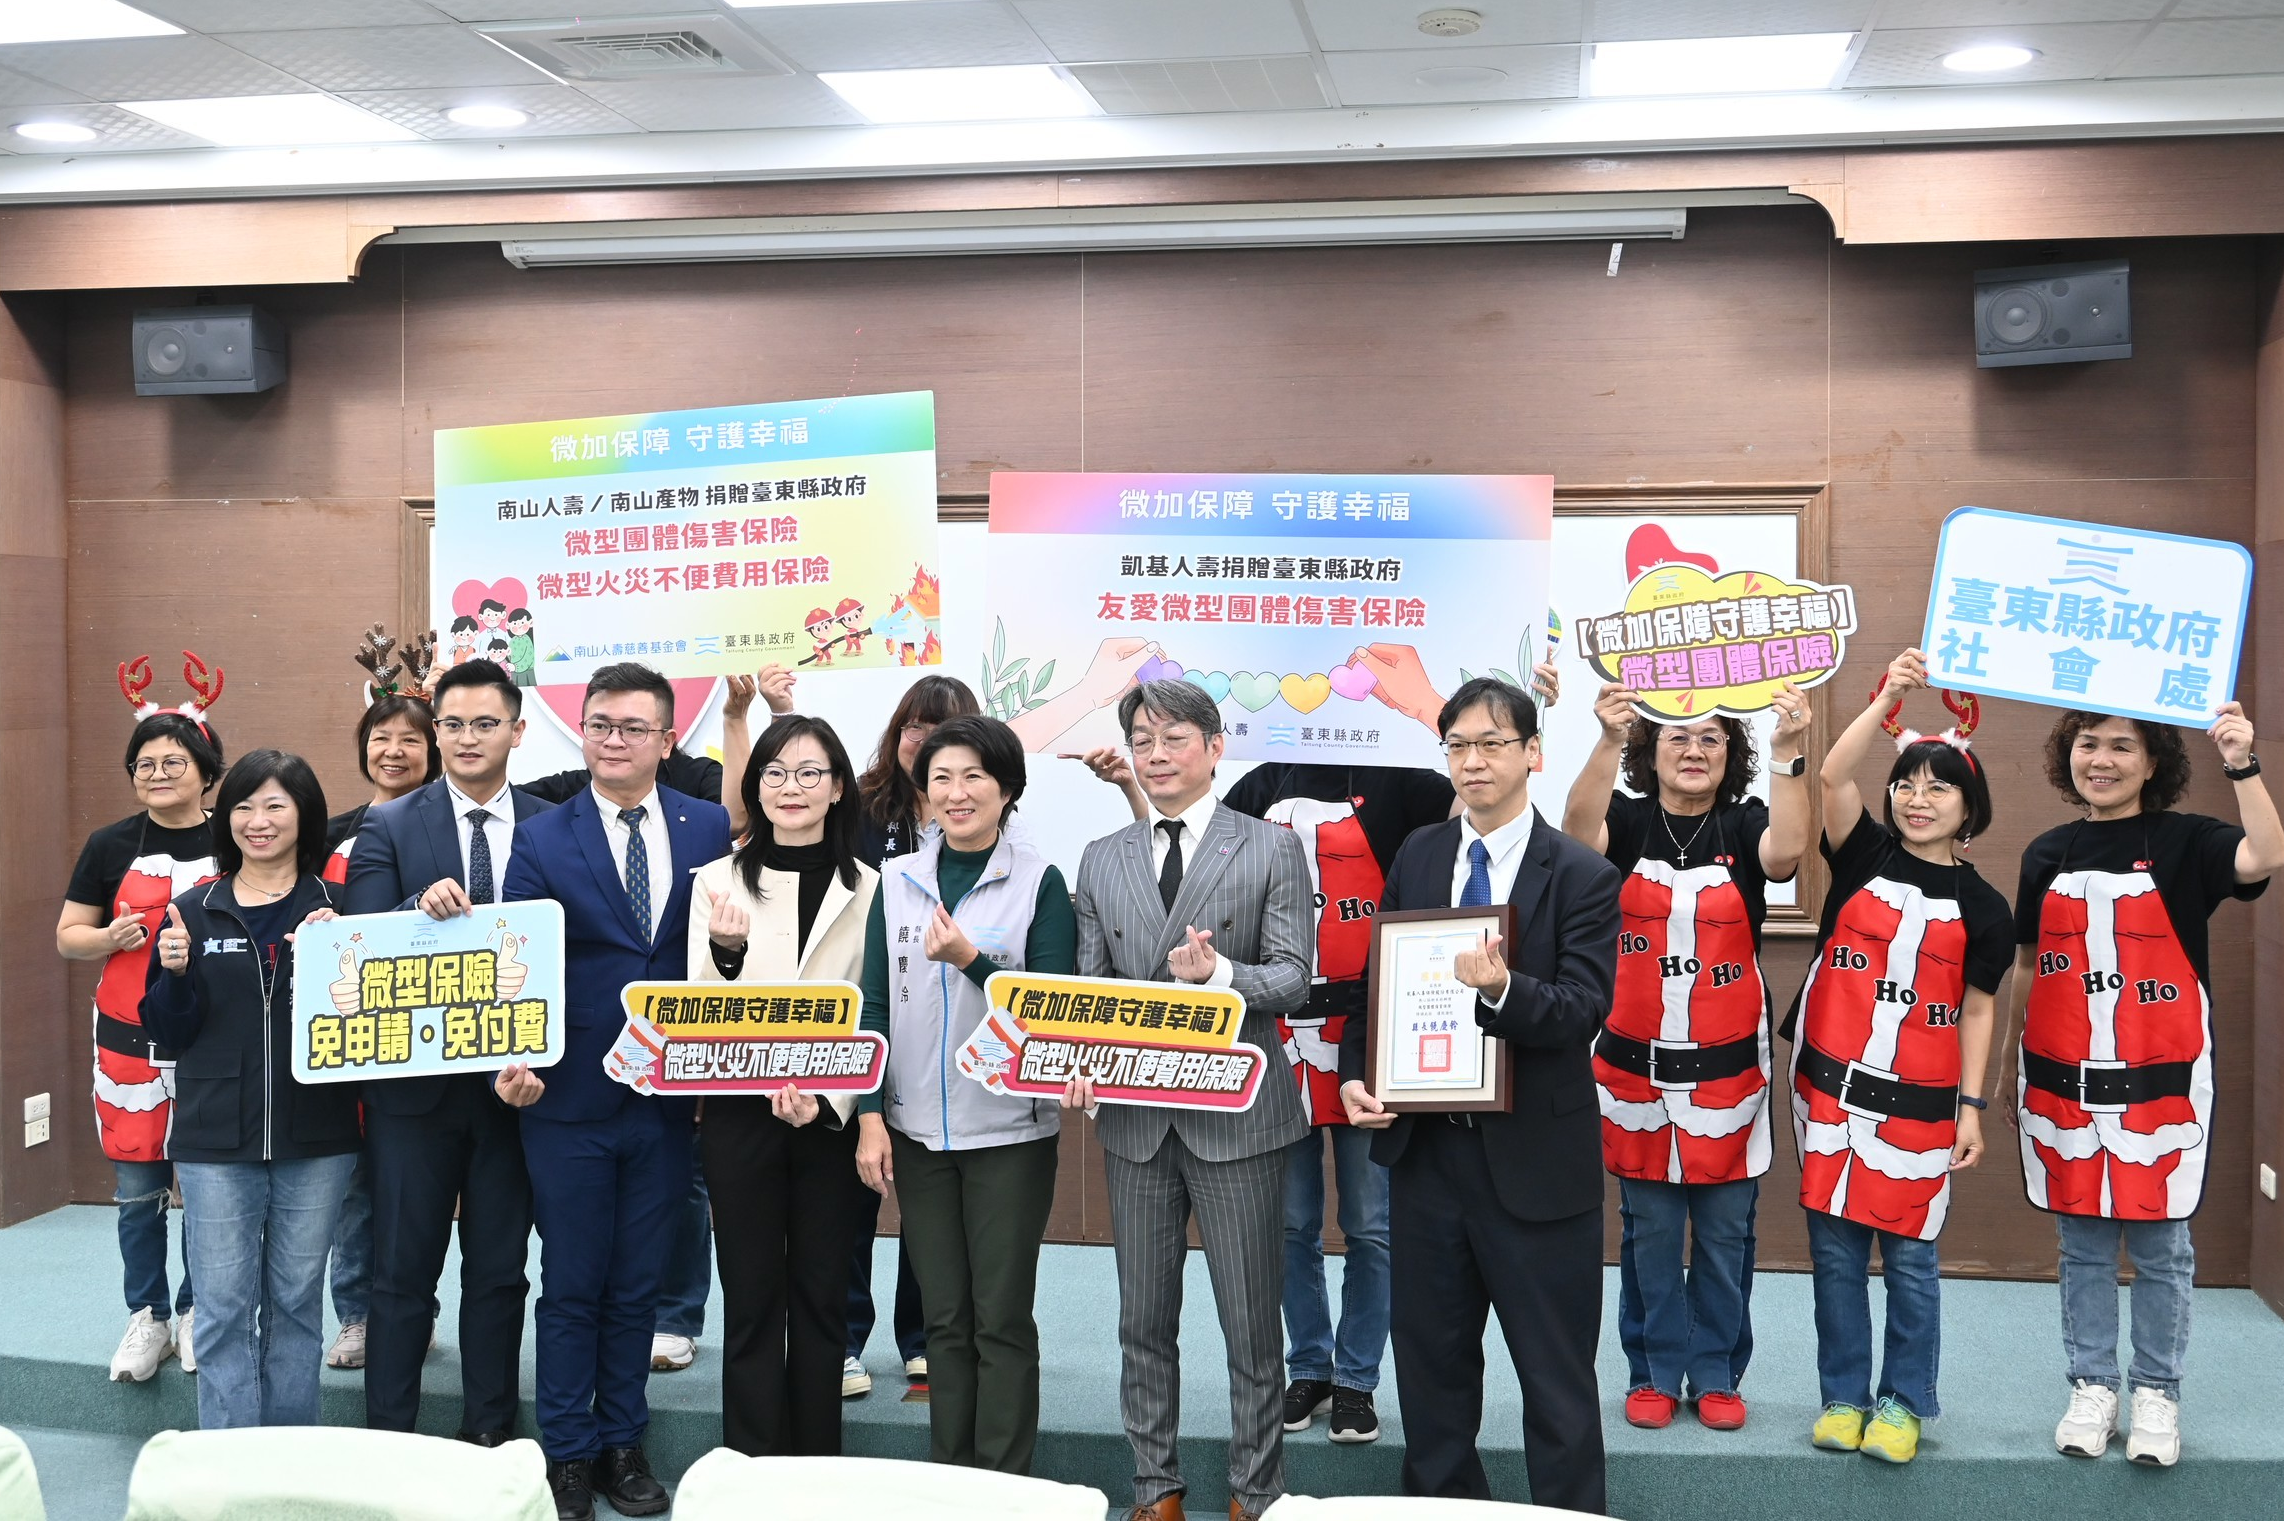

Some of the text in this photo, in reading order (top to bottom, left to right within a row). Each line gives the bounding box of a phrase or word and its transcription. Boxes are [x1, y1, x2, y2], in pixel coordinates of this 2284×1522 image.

[550, 416, 809, 463] 微加保障 守護幸福
[1119, 488, 1411, 523] 微加保障 守護幸福
[564, 515, 799, 558] 微型團體傷害保險
[536, 555, 831, 601] 微型火災不便費用保險
[1120, 554, 1402, 583] 凱基人壽捐贈臺東縣政府
[1096, 591, 1427, 628] 友愛微型團體傷害保險
[1577, 591, 1850, 657] 【微加保障守護幸福】
[1946, 577, 2222, 659] 臺東縣政府
[574, 639, 687, 658] 南山人壽慈善基金會
[724, 631, 796, 648] 臺東縣政府
[1619, 635, 1834, 690] 微型團體保險
[1301, 727, 1380, 743] 臺東縣政府
[1336, 897, 1376, 922] Ho
[361, 950, 496, 1011] 微型保險
[1620, 932, 1743, 988] Ho Ho Ho
[1830, 946, 1869, 970] Ho
[1874, 978, 1918, 1006] Ho
[2038, 951, 2178, 1003] Ho Ho Ho
[643, 995, 850, 1025] 【微加保障守護幸福】
[1006, 987, 1232, 1035] 【微加保障守護幸福】
[664, 1042, 876, 1081] 微型火災不便費用保險
[1019, 1040, 1253, 1092] 微型火災不便費用保險
